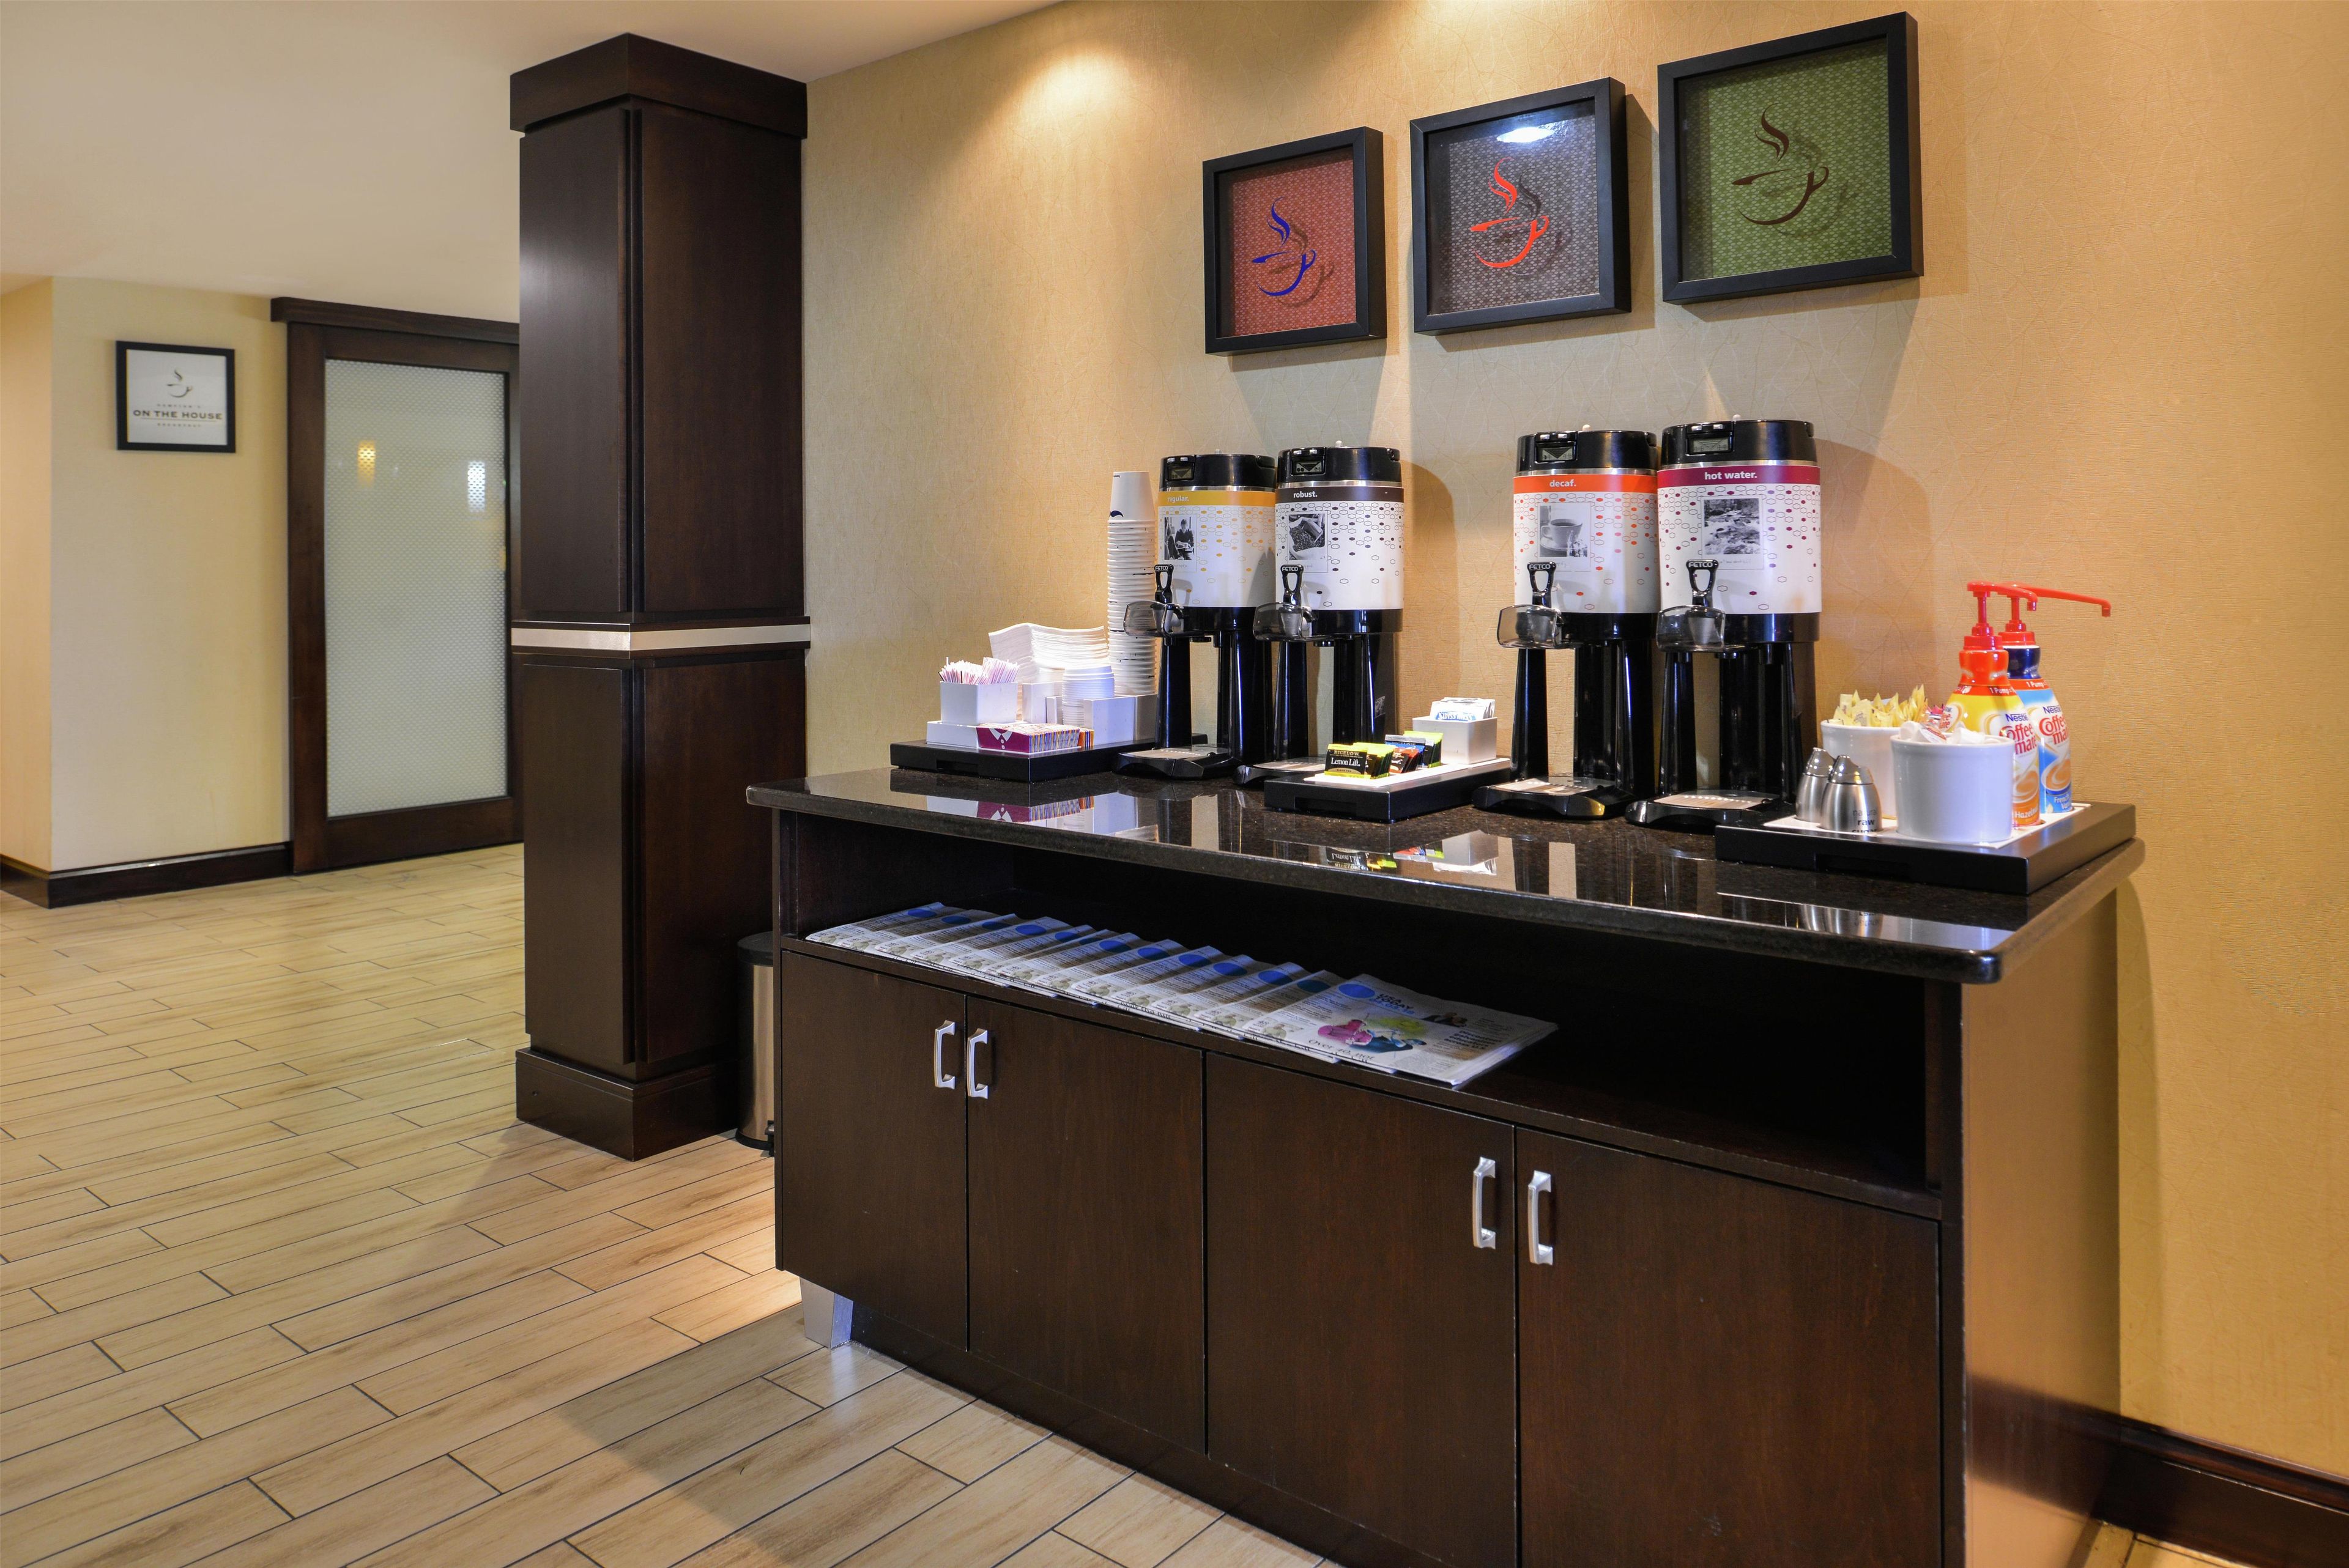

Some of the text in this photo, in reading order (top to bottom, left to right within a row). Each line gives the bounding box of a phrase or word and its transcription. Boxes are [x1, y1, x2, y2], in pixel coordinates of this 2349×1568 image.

[1704, 472, 1723, 480] hot
[1376, 996, 1414, 1010] TODAY
[1379, 993, 1401, 1002] USA
[1308, 1038, 1334, 1049] Over
[1355, 1052, 1375, 1060] not
